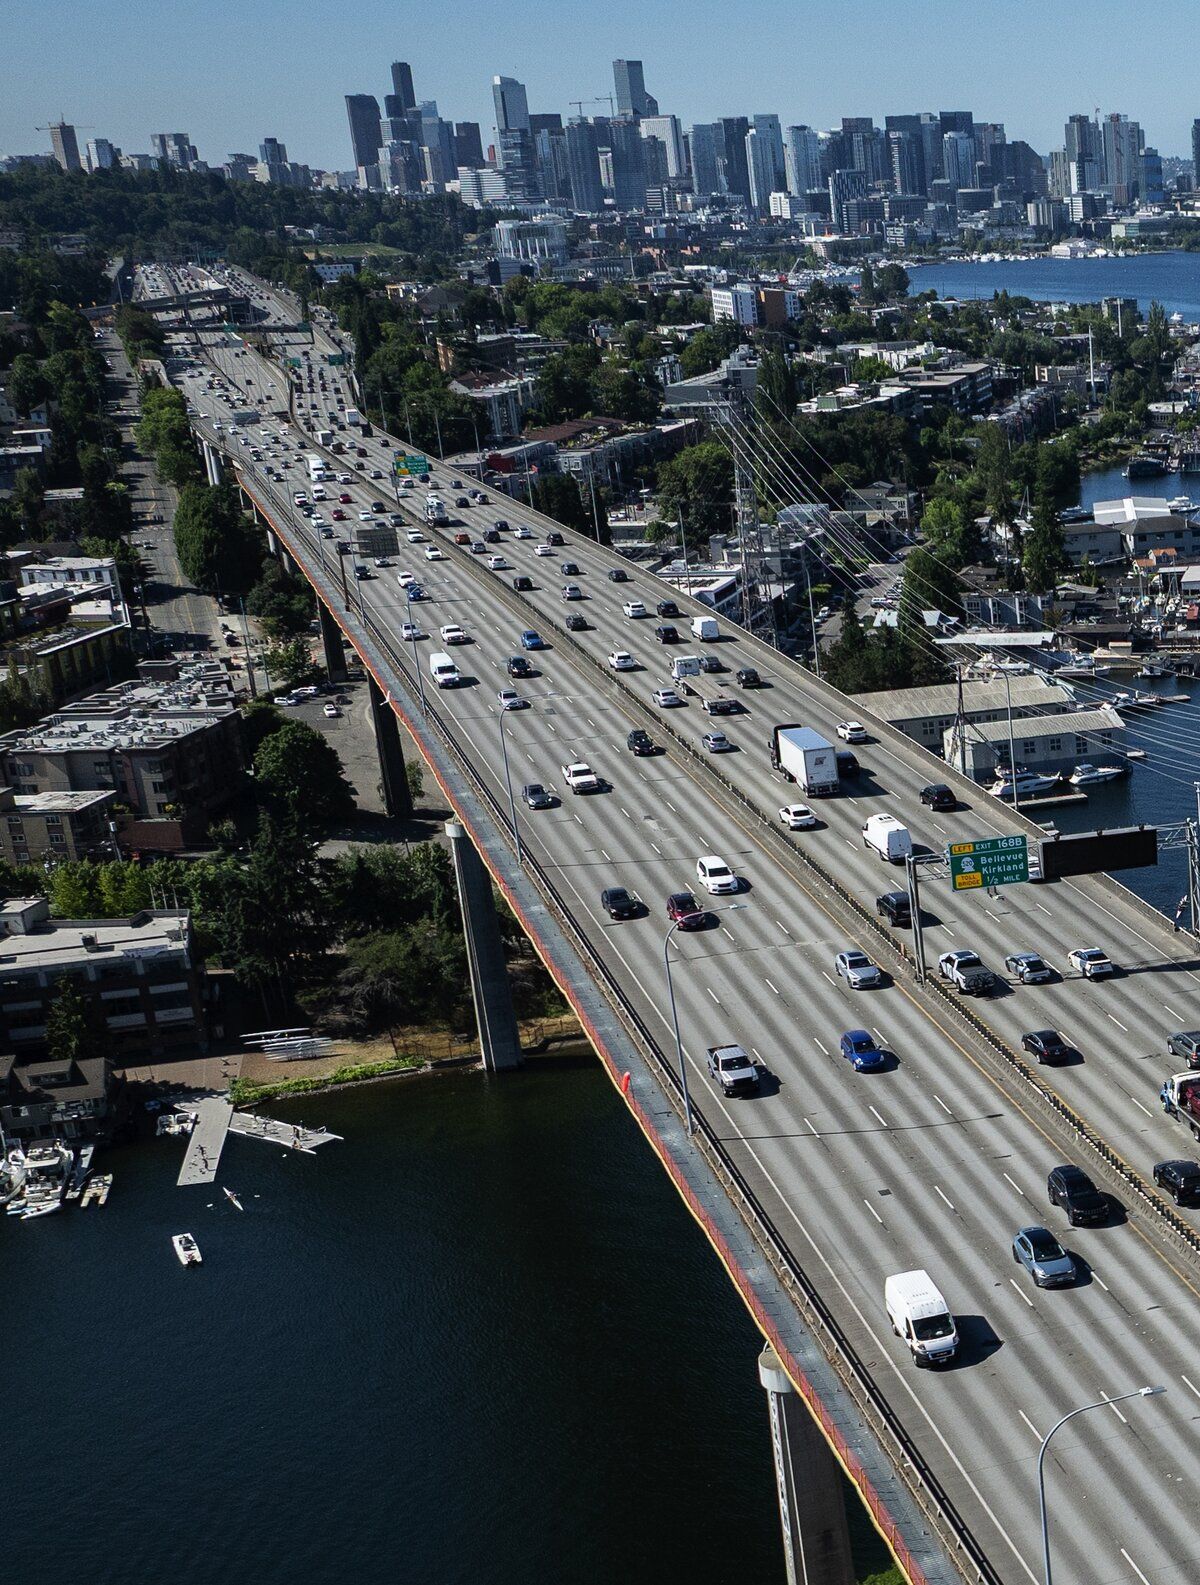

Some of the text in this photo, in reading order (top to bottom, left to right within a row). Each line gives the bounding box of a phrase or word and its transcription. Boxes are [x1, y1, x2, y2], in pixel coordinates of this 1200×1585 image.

[998, 837, 1022, 848] 168B
[981, 853, 1023, 864] Bellevue
[982, 862, 1024, 874] Kirkland
